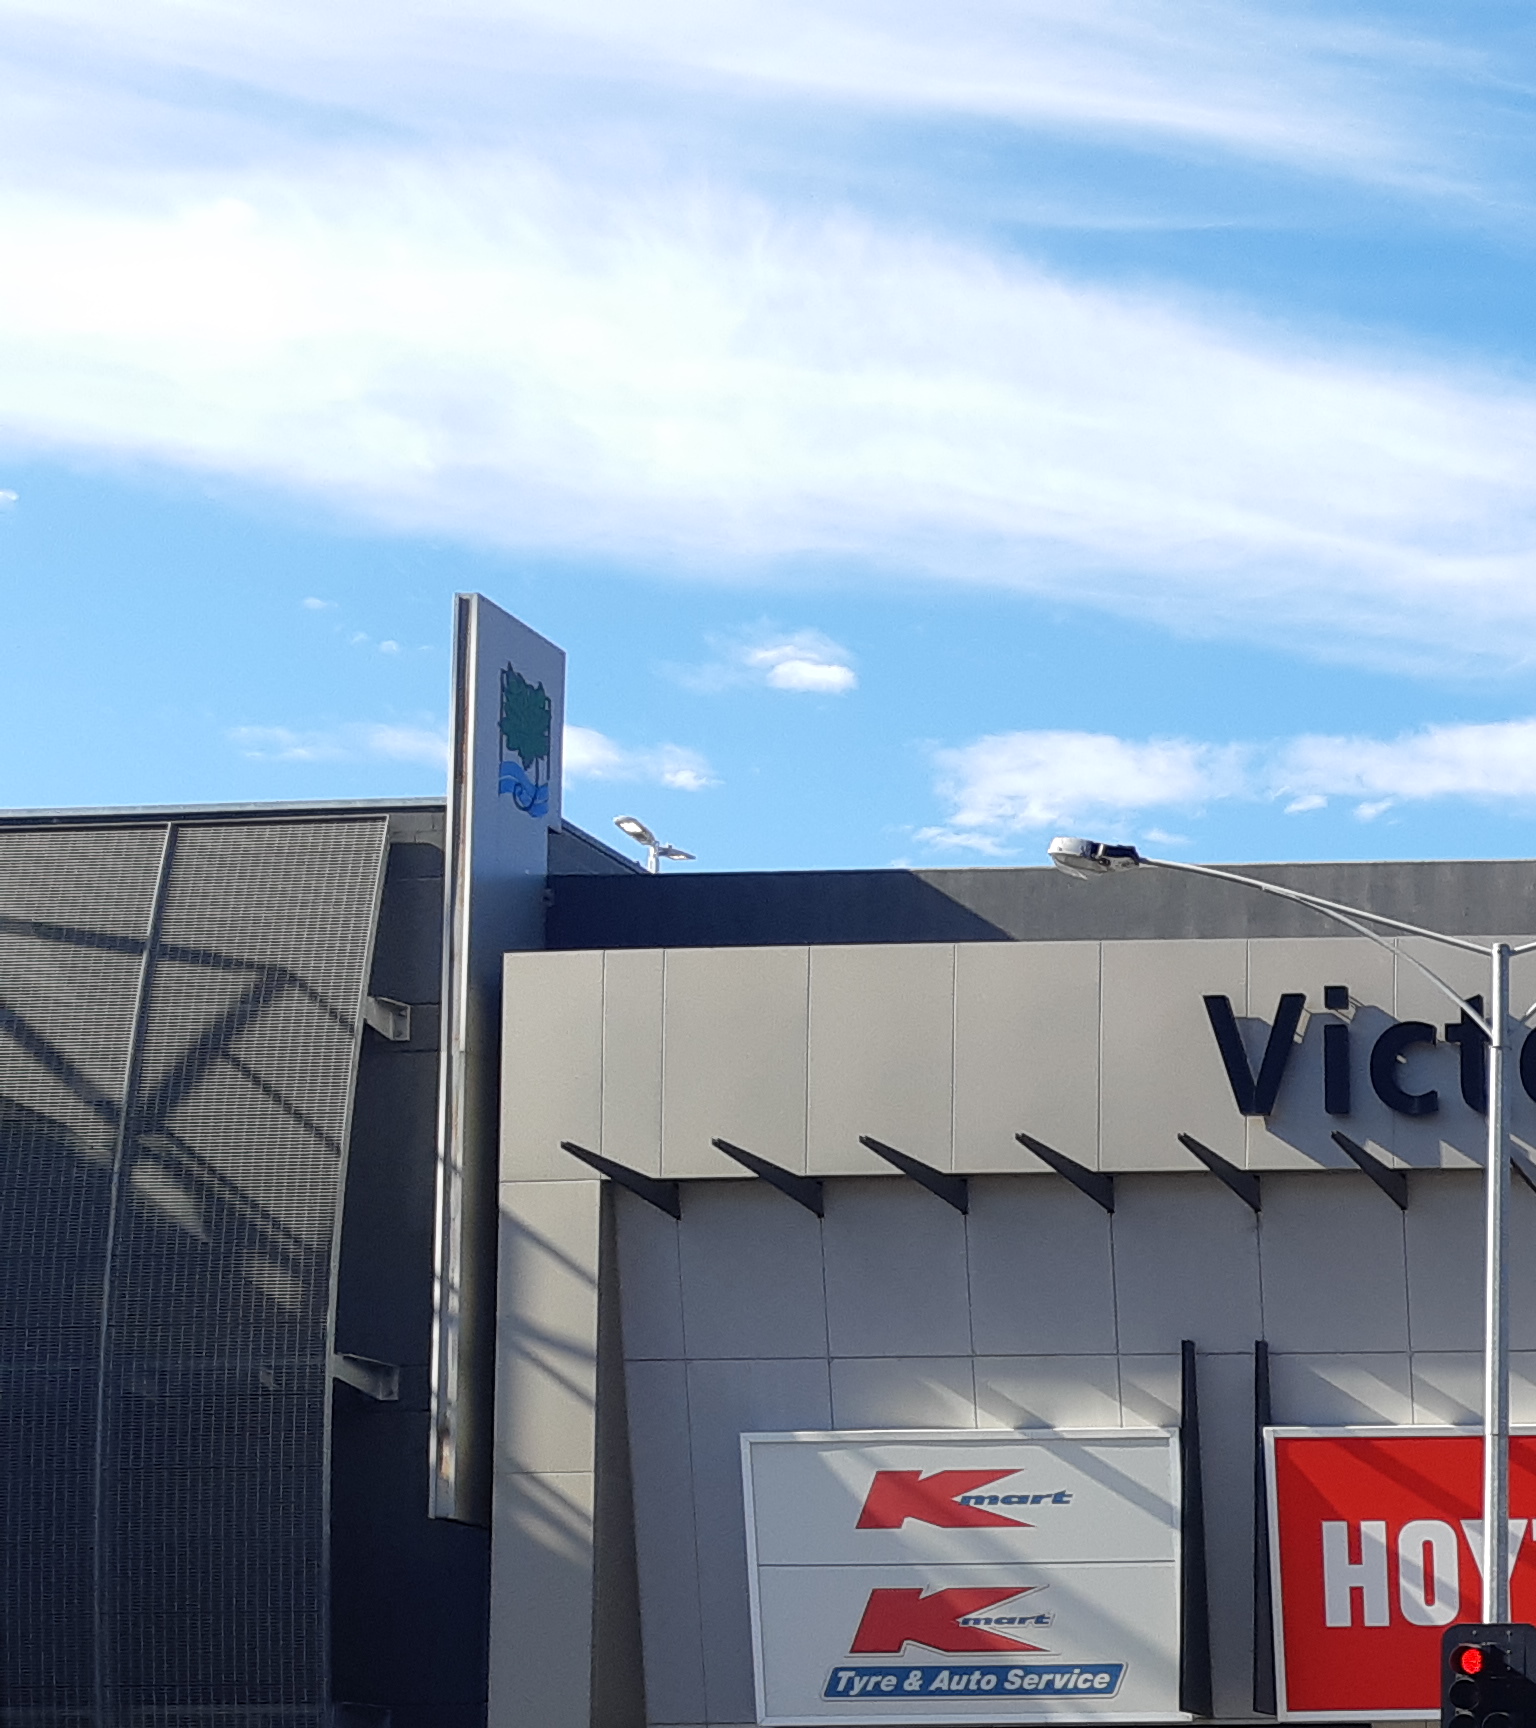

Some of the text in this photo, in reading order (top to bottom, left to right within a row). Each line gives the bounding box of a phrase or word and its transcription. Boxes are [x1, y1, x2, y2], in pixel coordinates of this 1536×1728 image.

[836, 1668, 1110, 1695] Tyre & Auto Service
